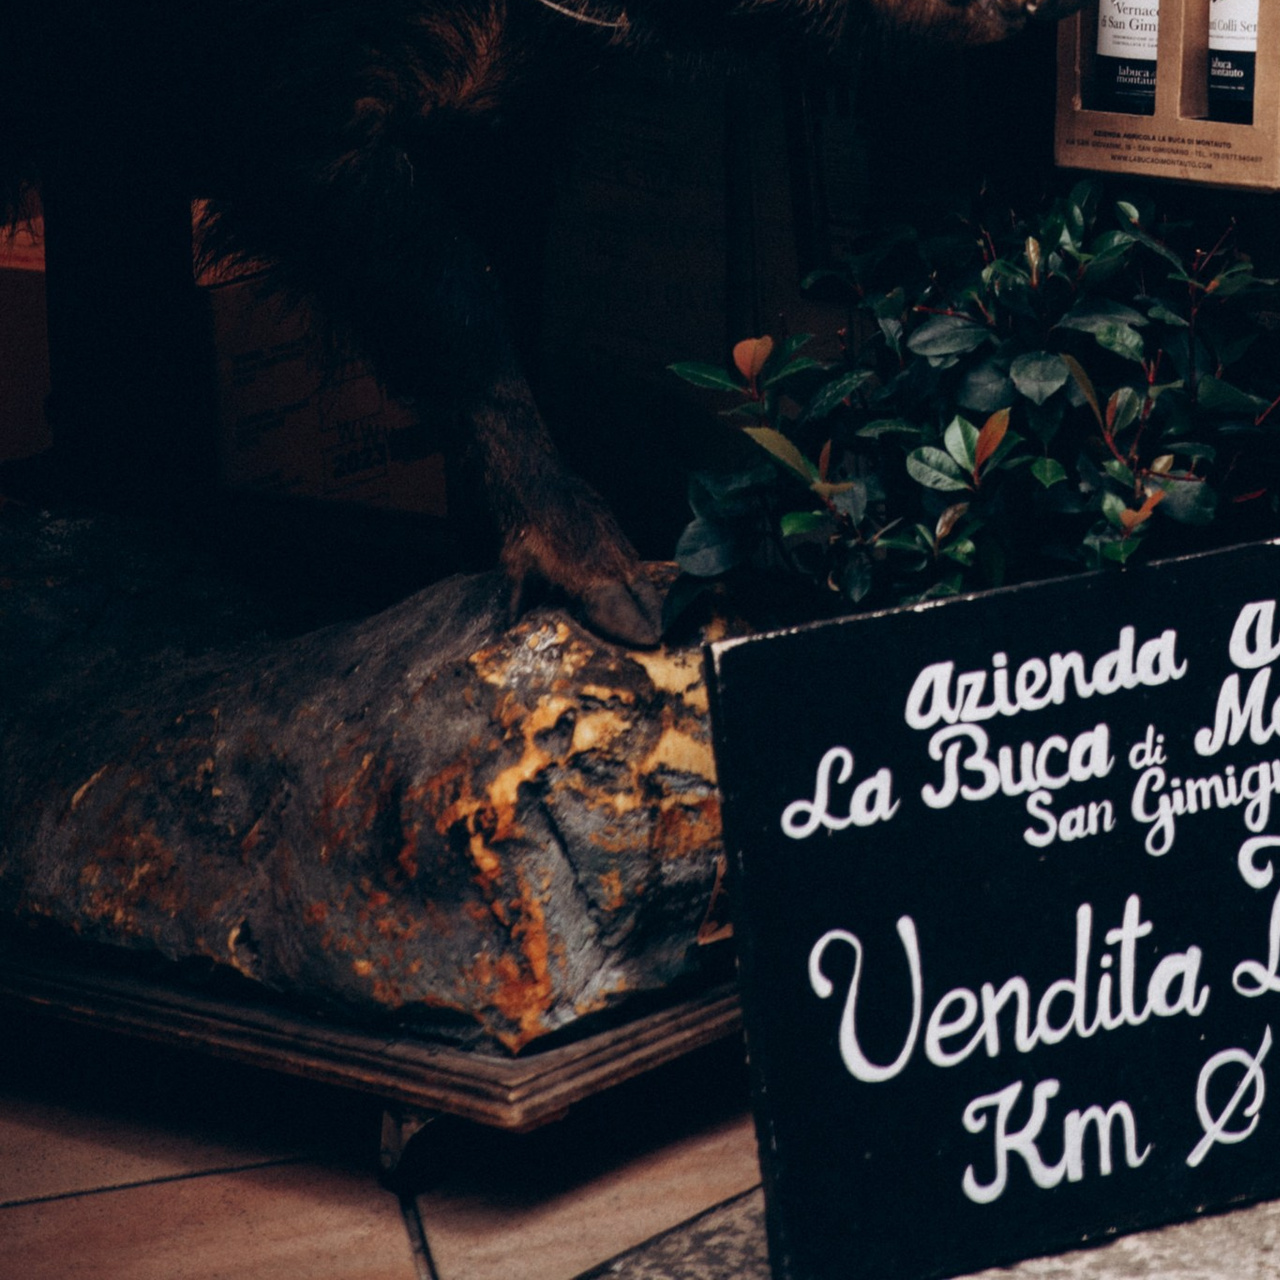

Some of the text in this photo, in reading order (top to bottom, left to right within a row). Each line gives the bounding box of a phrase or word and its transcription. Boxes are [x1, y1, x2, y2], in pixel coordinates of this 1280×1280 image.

[904, 625, 1188, 734] Azienda
[780, 745, 902, 840] La
[922, 724, 1116, 811] Buca
[1129, 731, 1167, 771] di
[1023, 789, 1119, 850] San
[807, 892, 1210, 1084] Vendita
[962, 1076, 1153, 1206] Km
